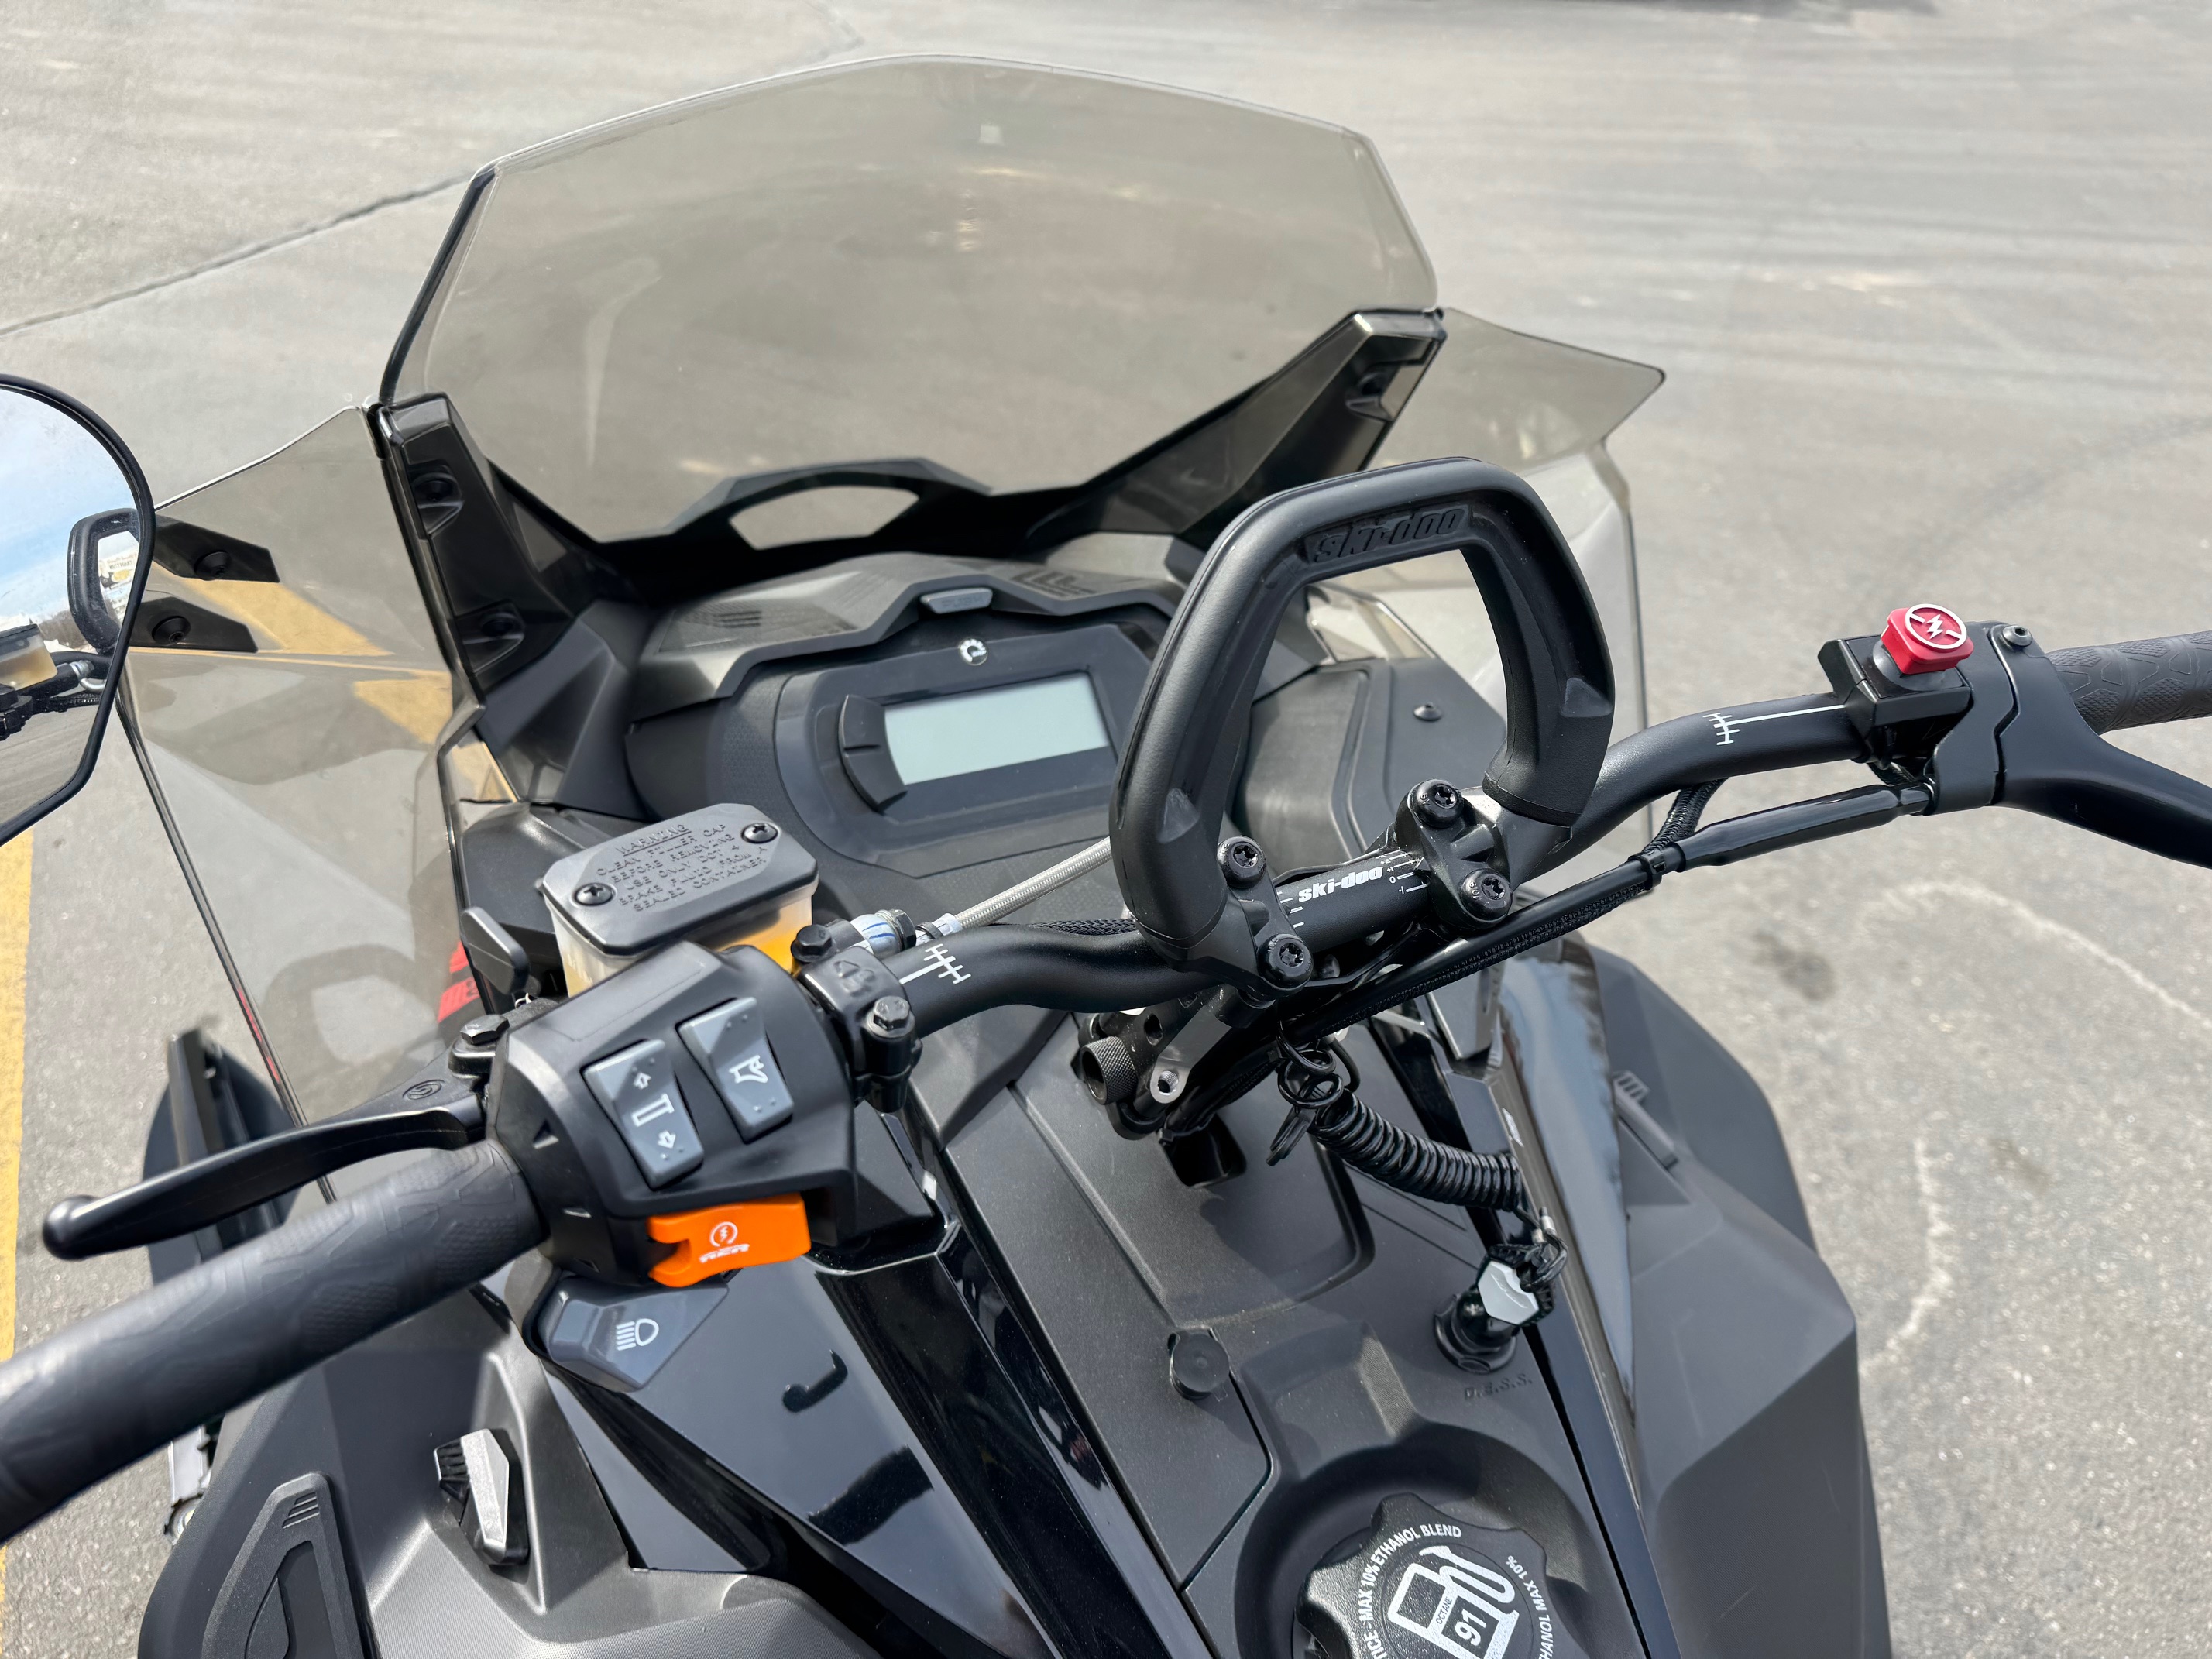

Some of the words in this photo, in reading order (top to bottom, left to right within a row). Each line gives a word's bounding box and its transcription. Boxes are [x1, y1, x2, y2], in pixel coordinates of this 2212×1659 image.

[596, 857, 641, 876] CLEAN
[647, 836, 697, 857] FILLER
[703, 824, 726, 837] CAP
[616, 824, 690, 854] WARNING
[611, 860, 663, 884] BEFORE
[670, 833, 735, 862] REMOVING
[623, 876, 652, 891] USE
[658, 860, 691, 878] ONLY
[698, 848, 723, 864] DOT
[619, 884, 663, 906] BRAKE
[670, 866, 712, 887] FLUID
[719, 853, 752, 868] FROM
[634, 888, 686, 912] SEALED
[692, 857, 767, 888] CONTAINER
[1298, 866, 1384, 902] ski-doo
[1370, 1527, 1422, 1566] ETHANOL
[1420, 1523, 1462, 1538] BLEND
[1360, 1563, 1381, 1588] 10%
[1505, 1555, 1528, 1580] 10%
[1358, 1588, 1374, 1621] MAX
[1435, 1596, 1453, 1625] OCTANE
[1523, 1579, 1547, 1611] MAX
[1364, 1630, 1388, 1659] TICE
[1455, 1608, 1487, 1647] 91
[1538, 1614, 1554, 1659] HANOL
